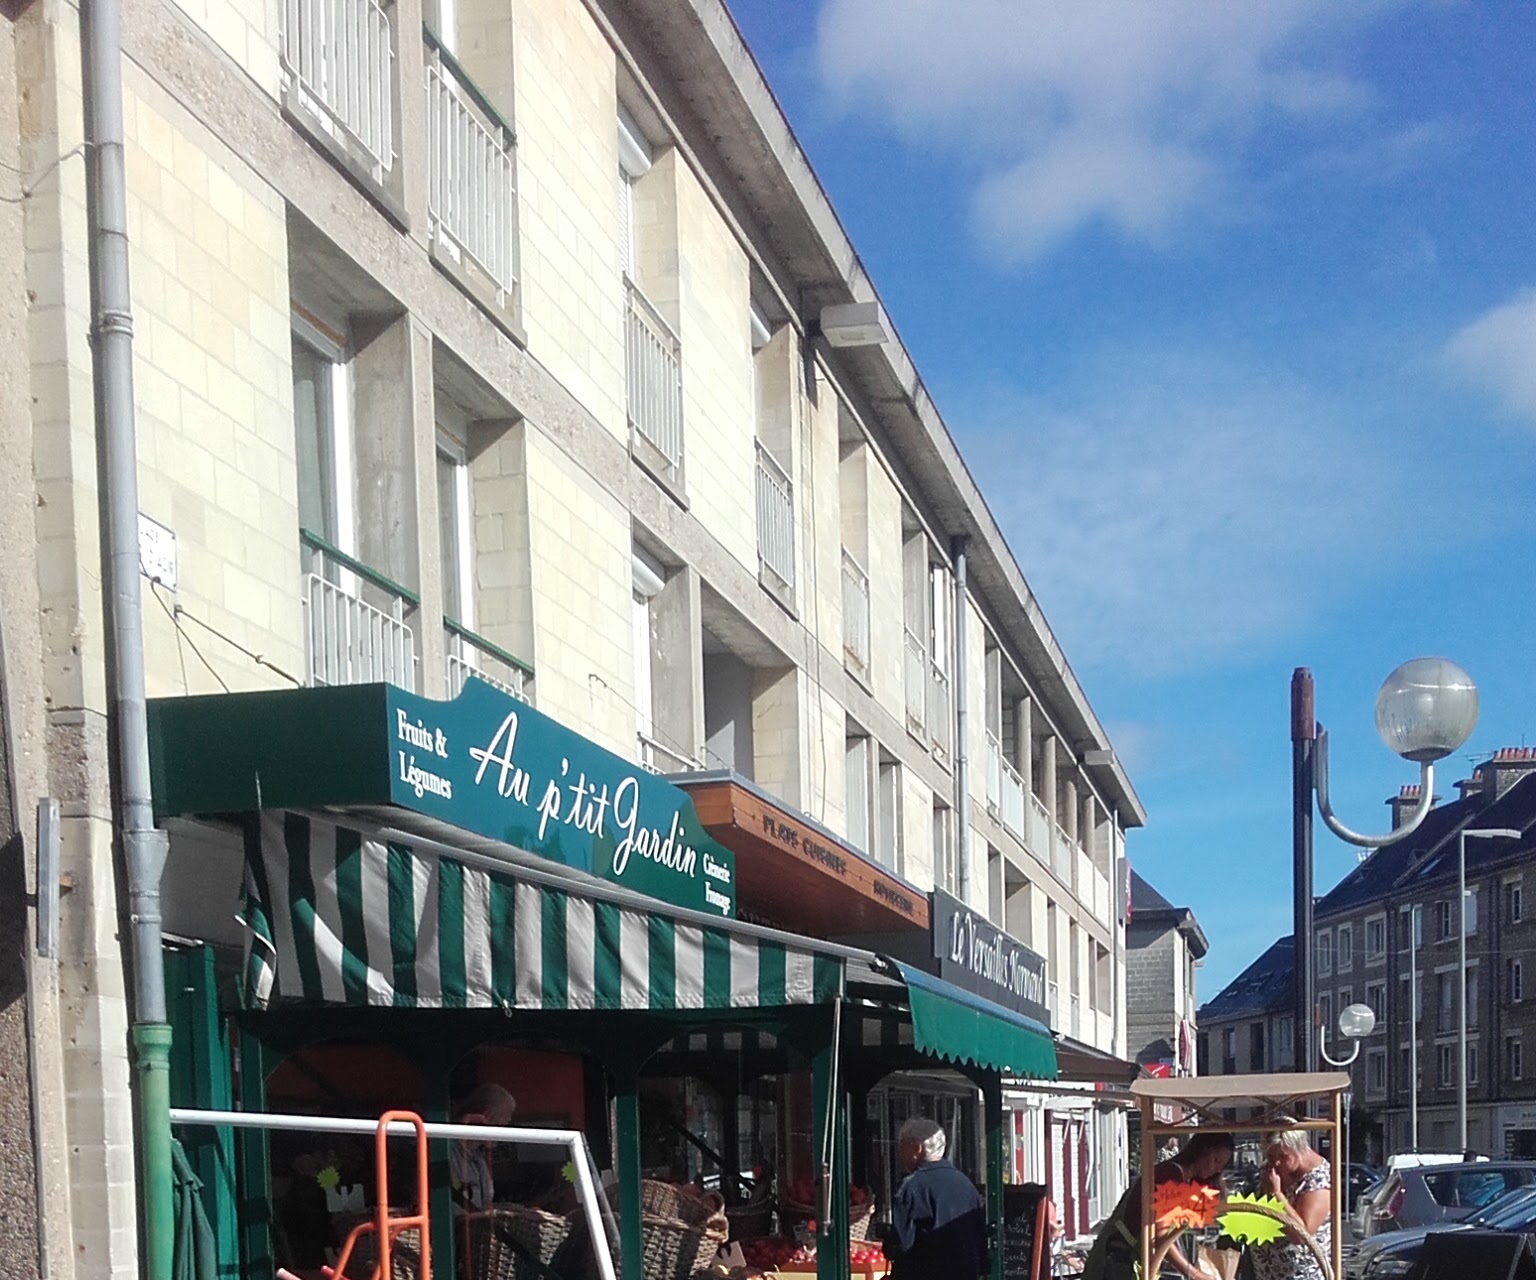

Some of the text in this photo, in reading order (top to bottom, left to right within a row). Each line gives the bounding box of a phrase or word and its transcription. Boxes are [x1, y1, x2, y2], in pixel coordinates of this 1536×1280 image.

[396, 708, 448, 758] Fruits &
[398, 751, 452, 799] Légumes
[469, 711, 697, 877] Au p'tit Jardin
[763, 815, 798, 849] PLATS
[951, 911, 964, 965] Le
